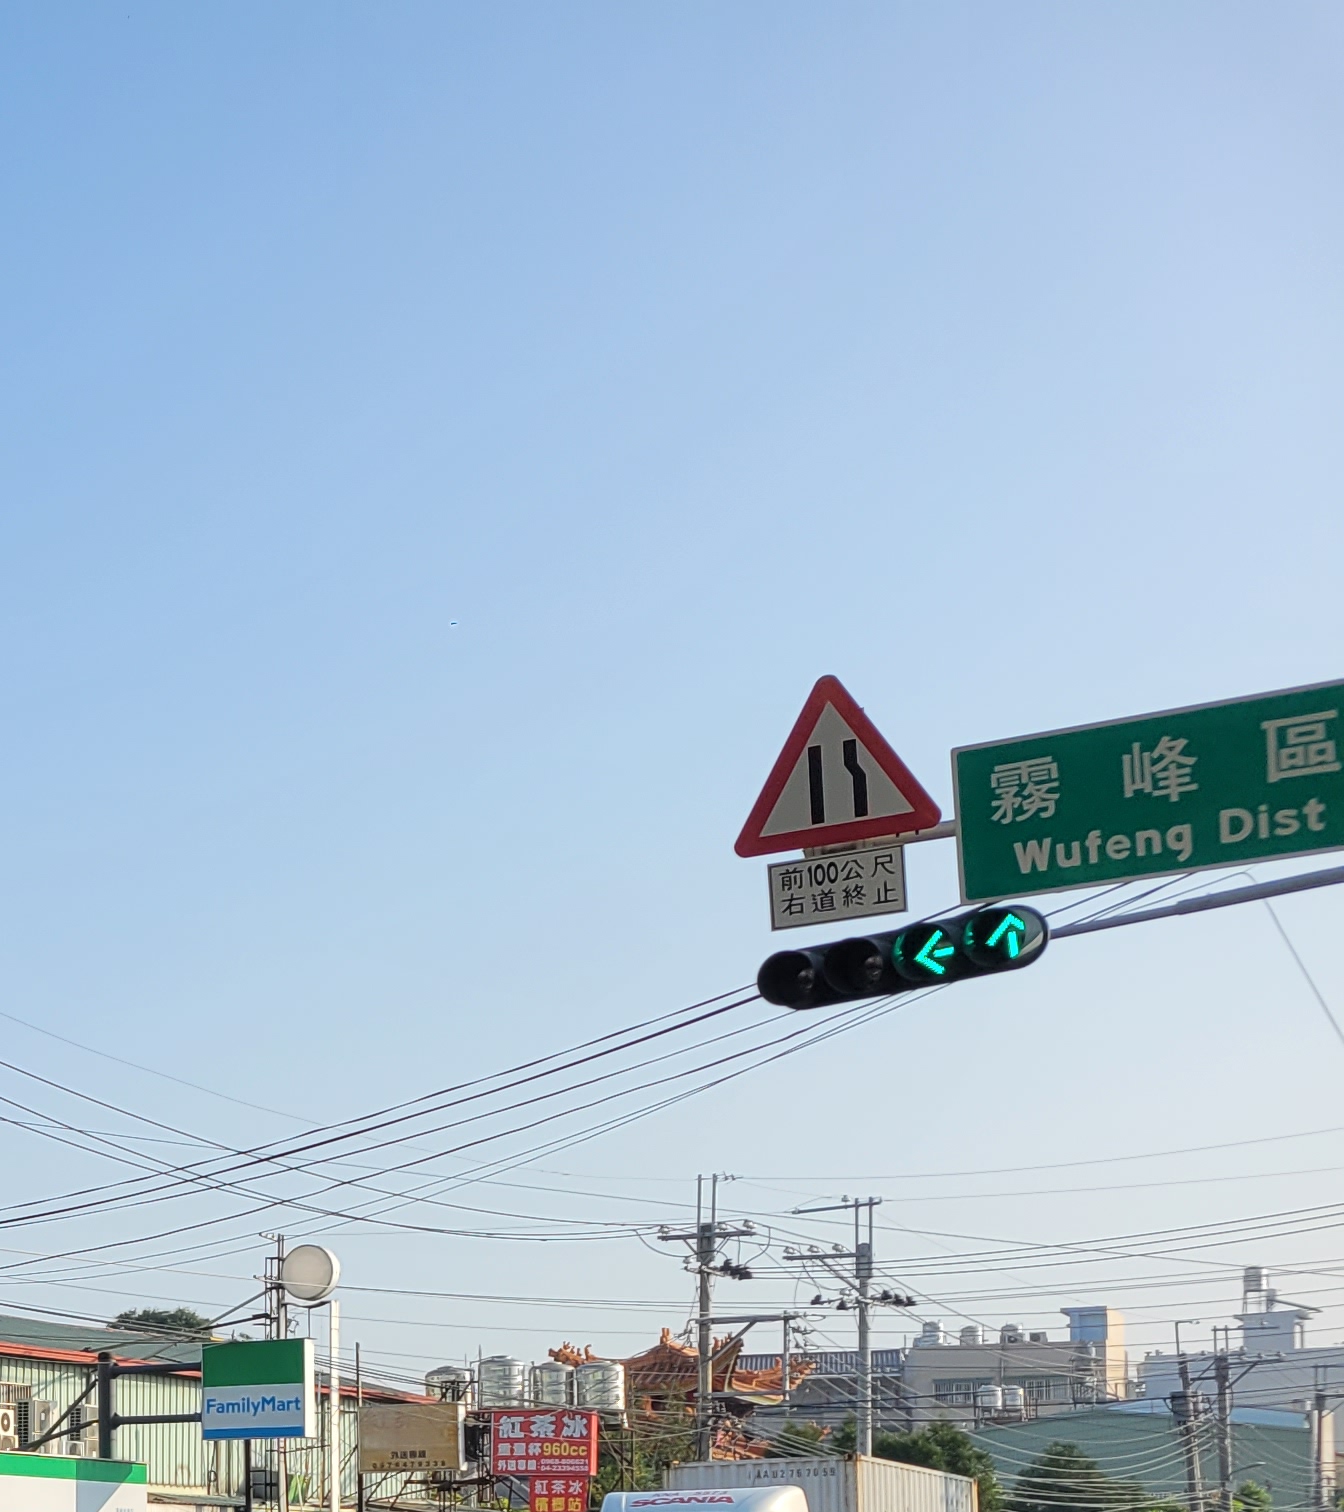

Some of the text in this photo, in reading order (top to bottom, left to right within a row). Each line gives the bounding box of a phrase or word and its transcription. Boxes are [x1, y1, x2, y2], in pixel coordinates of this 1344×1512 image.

[990, 709, 1342, 825] 霧峰區
[1013, 797, 1327, 875] Wufeng Dist
[779, 853, 896, 892] 前100公尺
[780, 880, 900, 917] 右道終止
[205, 1395, 302, 1418] FamilyMart
[499, 1415, 588, 1439] 紅茶冰
[630, 1495, 735, 1508] SCANIA
